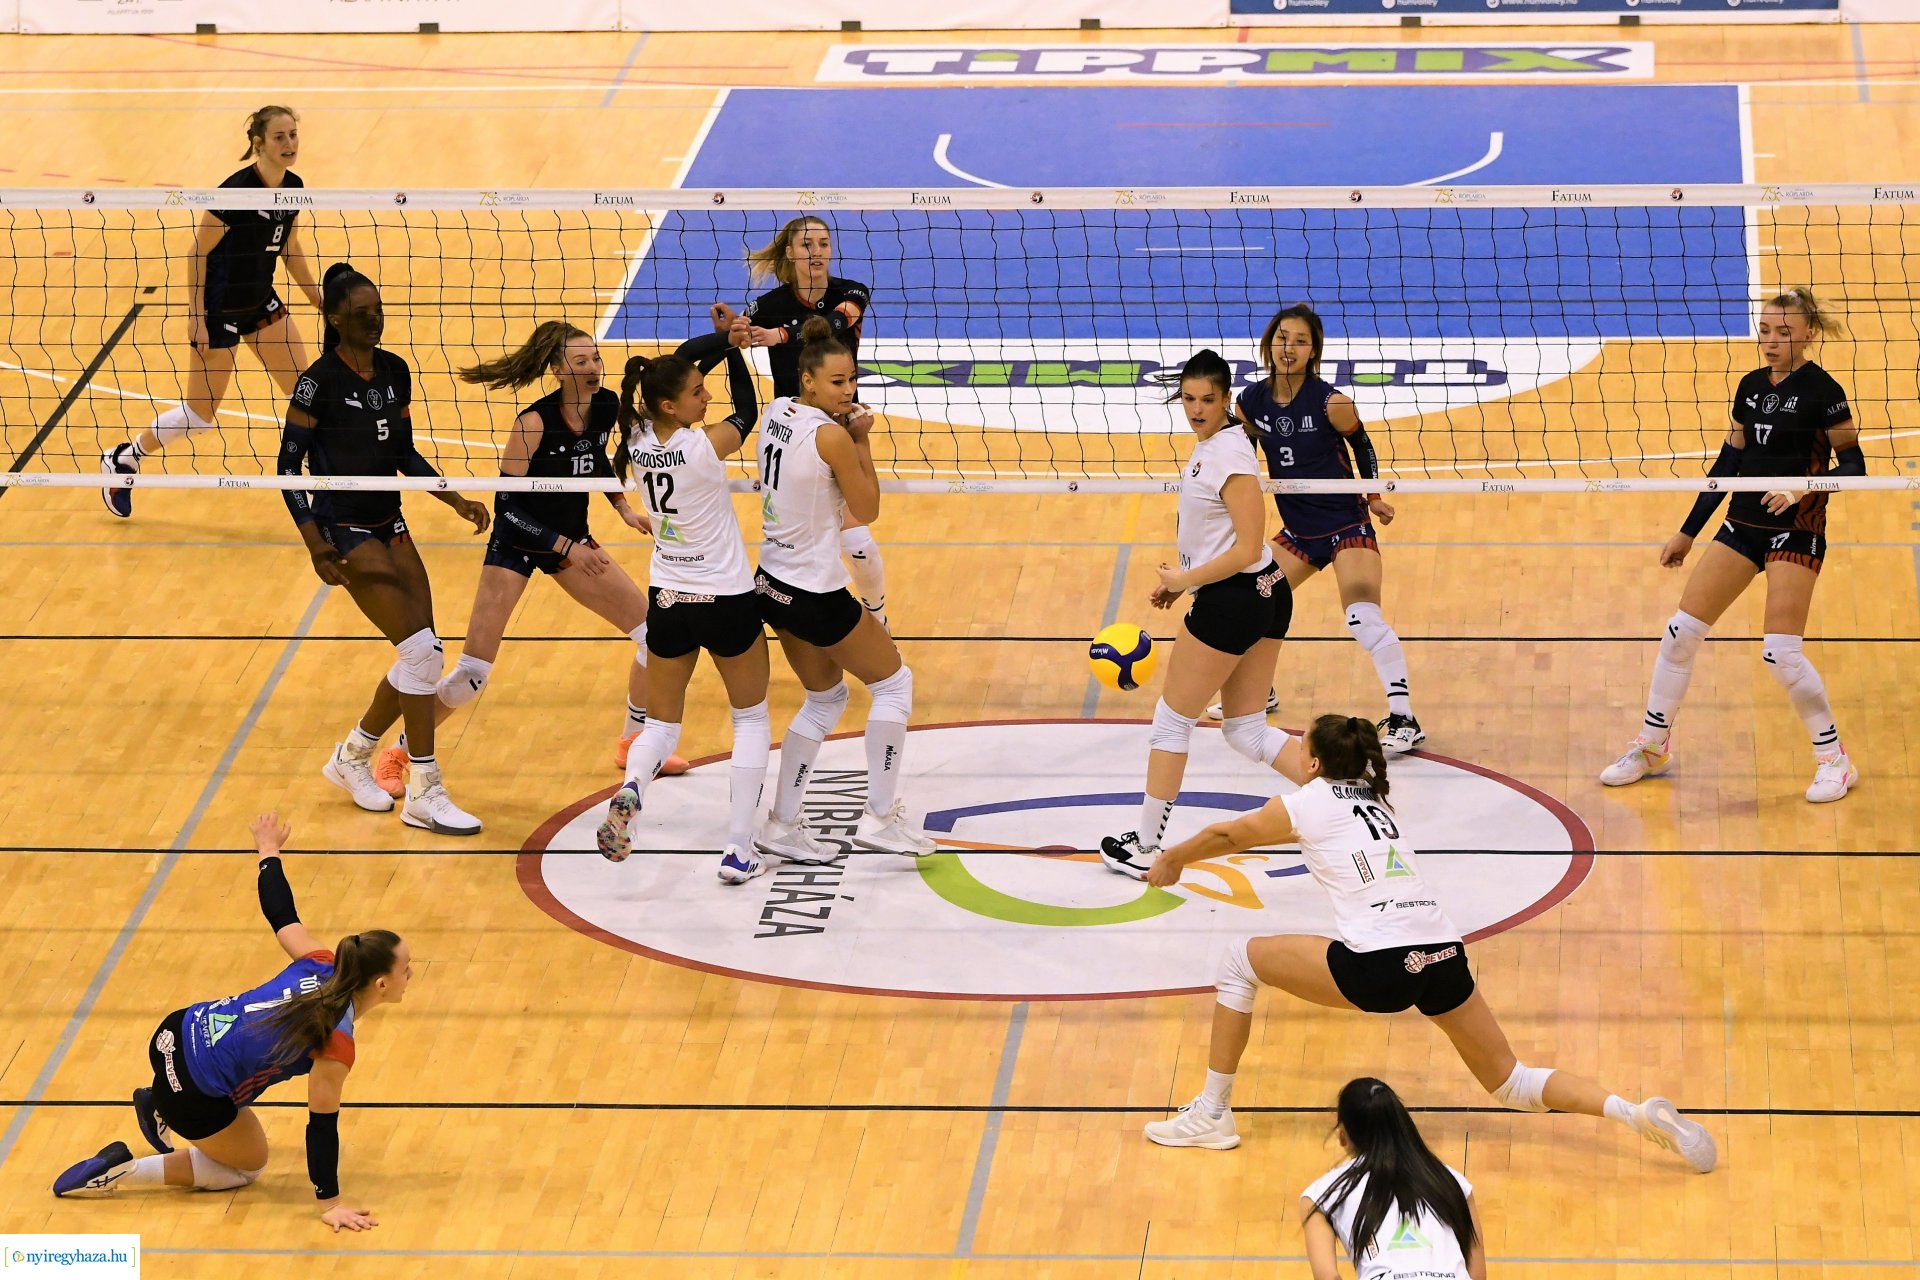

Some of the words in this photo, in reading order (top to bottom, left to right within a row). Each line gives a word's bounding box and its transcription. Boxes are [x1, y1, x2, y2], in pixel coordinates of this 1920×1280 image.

[272, 224, 283, 243] 8
[376, 419, 389, 441] 5
[766, 418, 793, 445] PINTÉR
[1754, 423, 1773, 445] 17
[570, 453, 594, 476] 16
[763, 443, 783, 492] 11
[1279, 446, 1295, 467] 3
[642, 471, 679, 515] 12
[1163, 482, 1182, 493] FAT
[1353, 804, 1400, 840] 19
